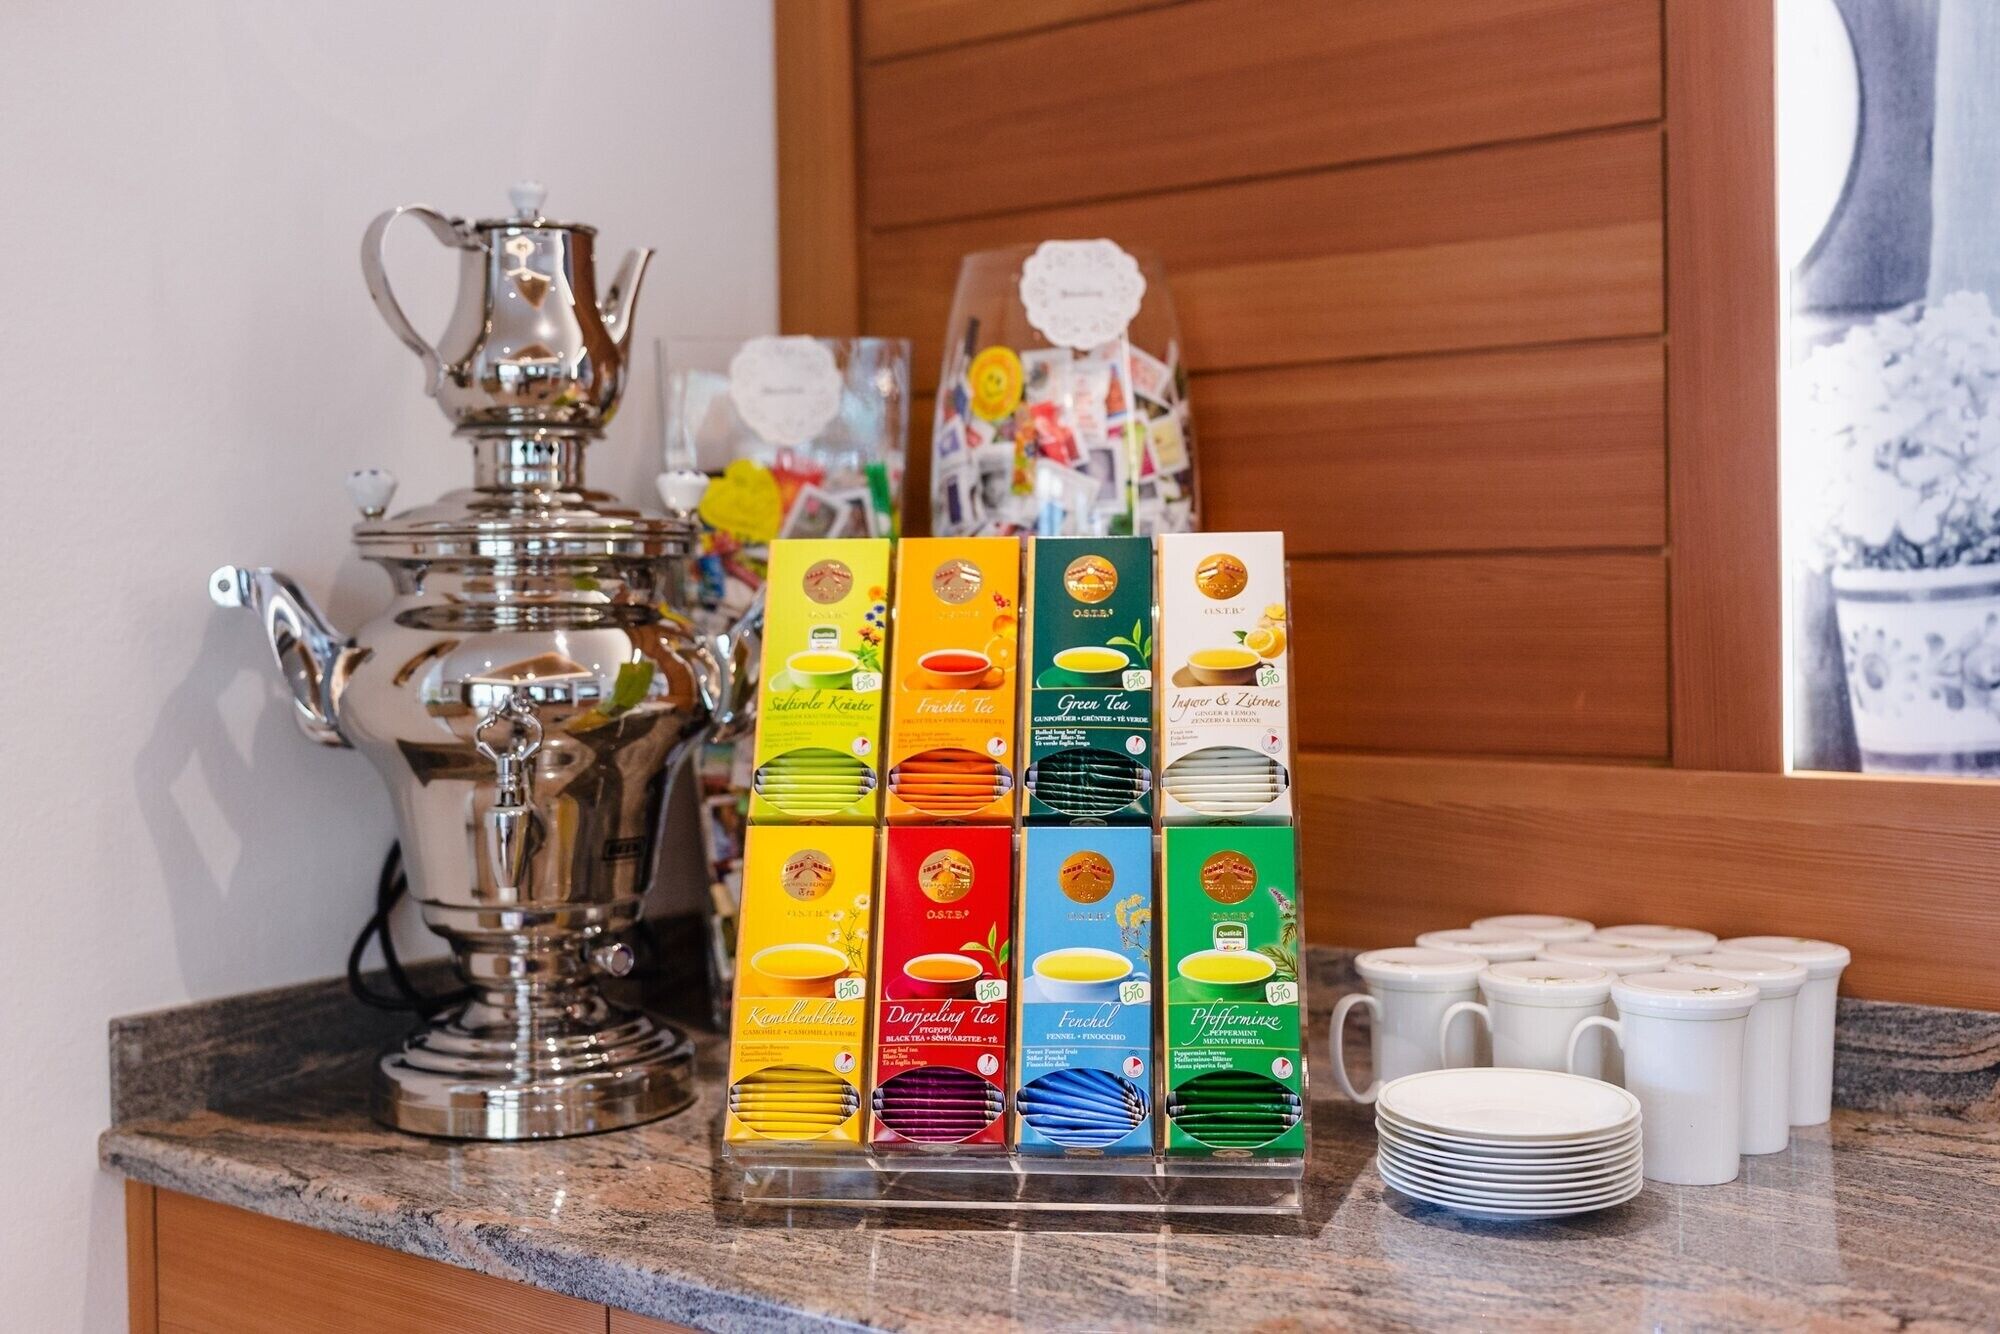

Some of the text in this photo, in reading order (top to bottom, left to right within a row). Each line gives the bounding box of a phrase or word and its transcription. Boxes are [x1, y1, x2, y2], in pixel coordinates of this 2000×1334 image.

[856, 675, 876, 690] bio
[1127, 671, 1146, 689] bio
[1260, 669, 1280, 687] bio
[768, 689, 874, 714] Südtiroler Kräuter
[917, 689, 995, 713] Früchte Tee
[1057, 692, 1131, 716] Green Tea
[1169, 692, 1281, 722] Ingwer & Zitrone
[1081, 714, 1112, 722] GRÜNTEE
[1054, 729, 1065, 737] long
[838, 979, 859, 999] bio
[979, 981, 1000, 1000] bio
[1123, 983, 1144, 1002] bio
[1270, 984, 1290, 1003] bio
[747, 1000, 856, 1027] Kamillenblüten
[886, 998, 1000, 1036] Darjeeling Tea
[1058, 1001, 1121, 1028] Fenchel
[1181, 998, 1283, 1046] Pfefferminze
